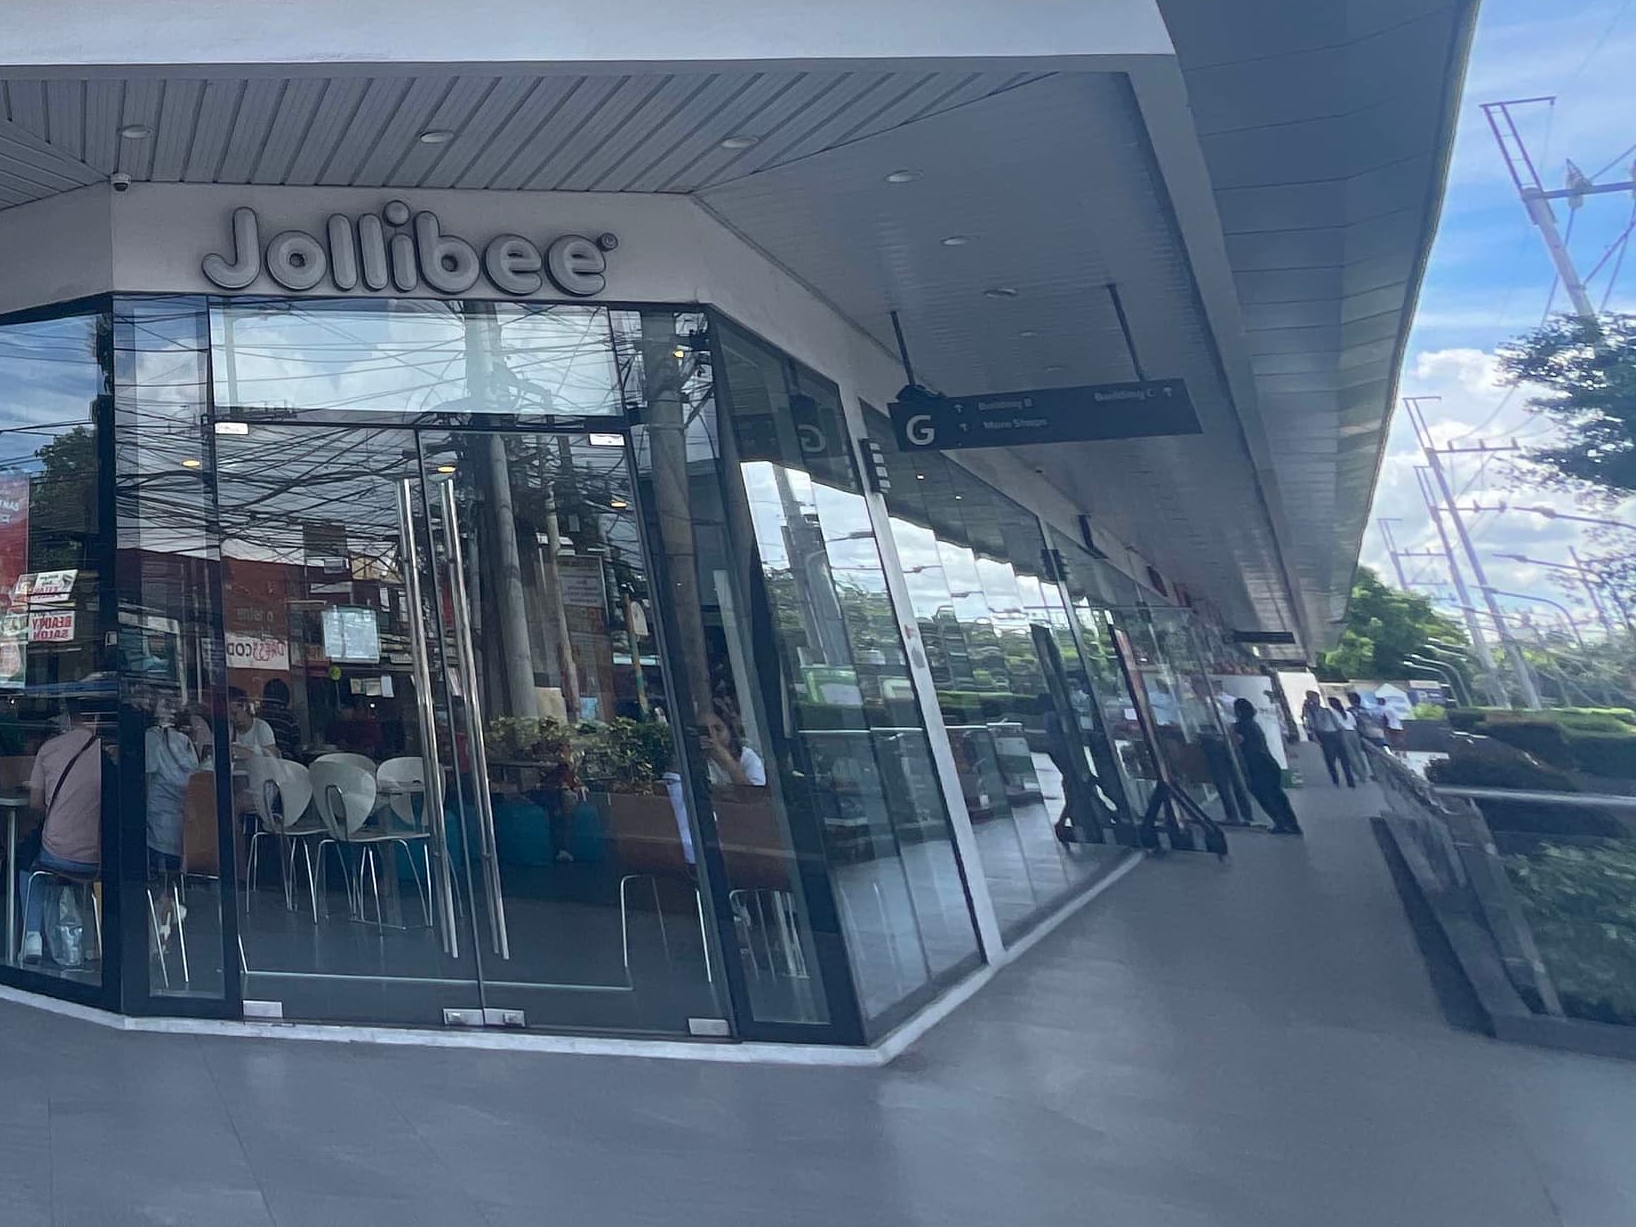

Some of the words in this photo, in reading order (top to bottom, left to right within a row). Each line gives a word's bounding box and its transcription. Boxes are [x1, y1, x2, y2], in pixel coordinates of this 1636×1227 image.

[201, 198, 608, 297] Jollibee
[977, 400, 1023, 411] Building
[1093, 389, 1146, 403] Building
[906, 414, 936, 446] G
